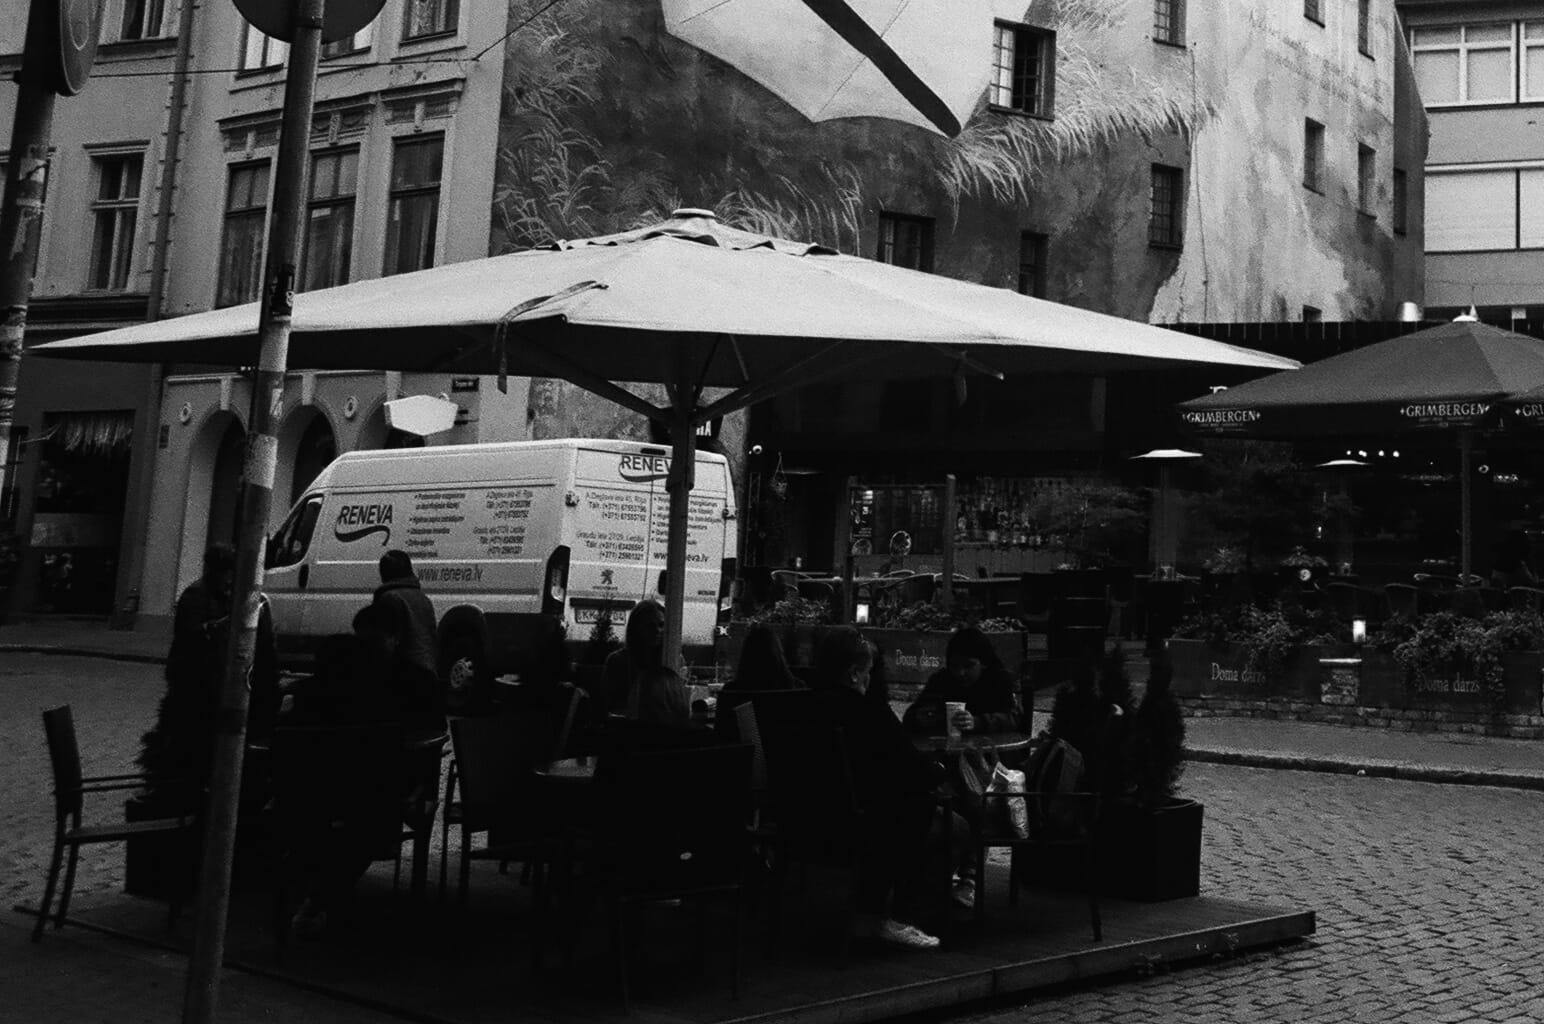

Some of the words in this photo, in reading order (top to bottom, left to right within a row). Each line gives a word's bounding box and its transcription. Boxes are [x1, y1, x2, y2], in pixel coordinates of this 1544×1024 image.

[1186, 410, 1256, 424] GRIMBERGEN
[1406, 402, 1486, 417] GRIMBERGEN
[621, 456, 673, 473] RENEV
[338, 504, 393, 525] RENEVA
[1211, 662, 1239, 681] Doma
